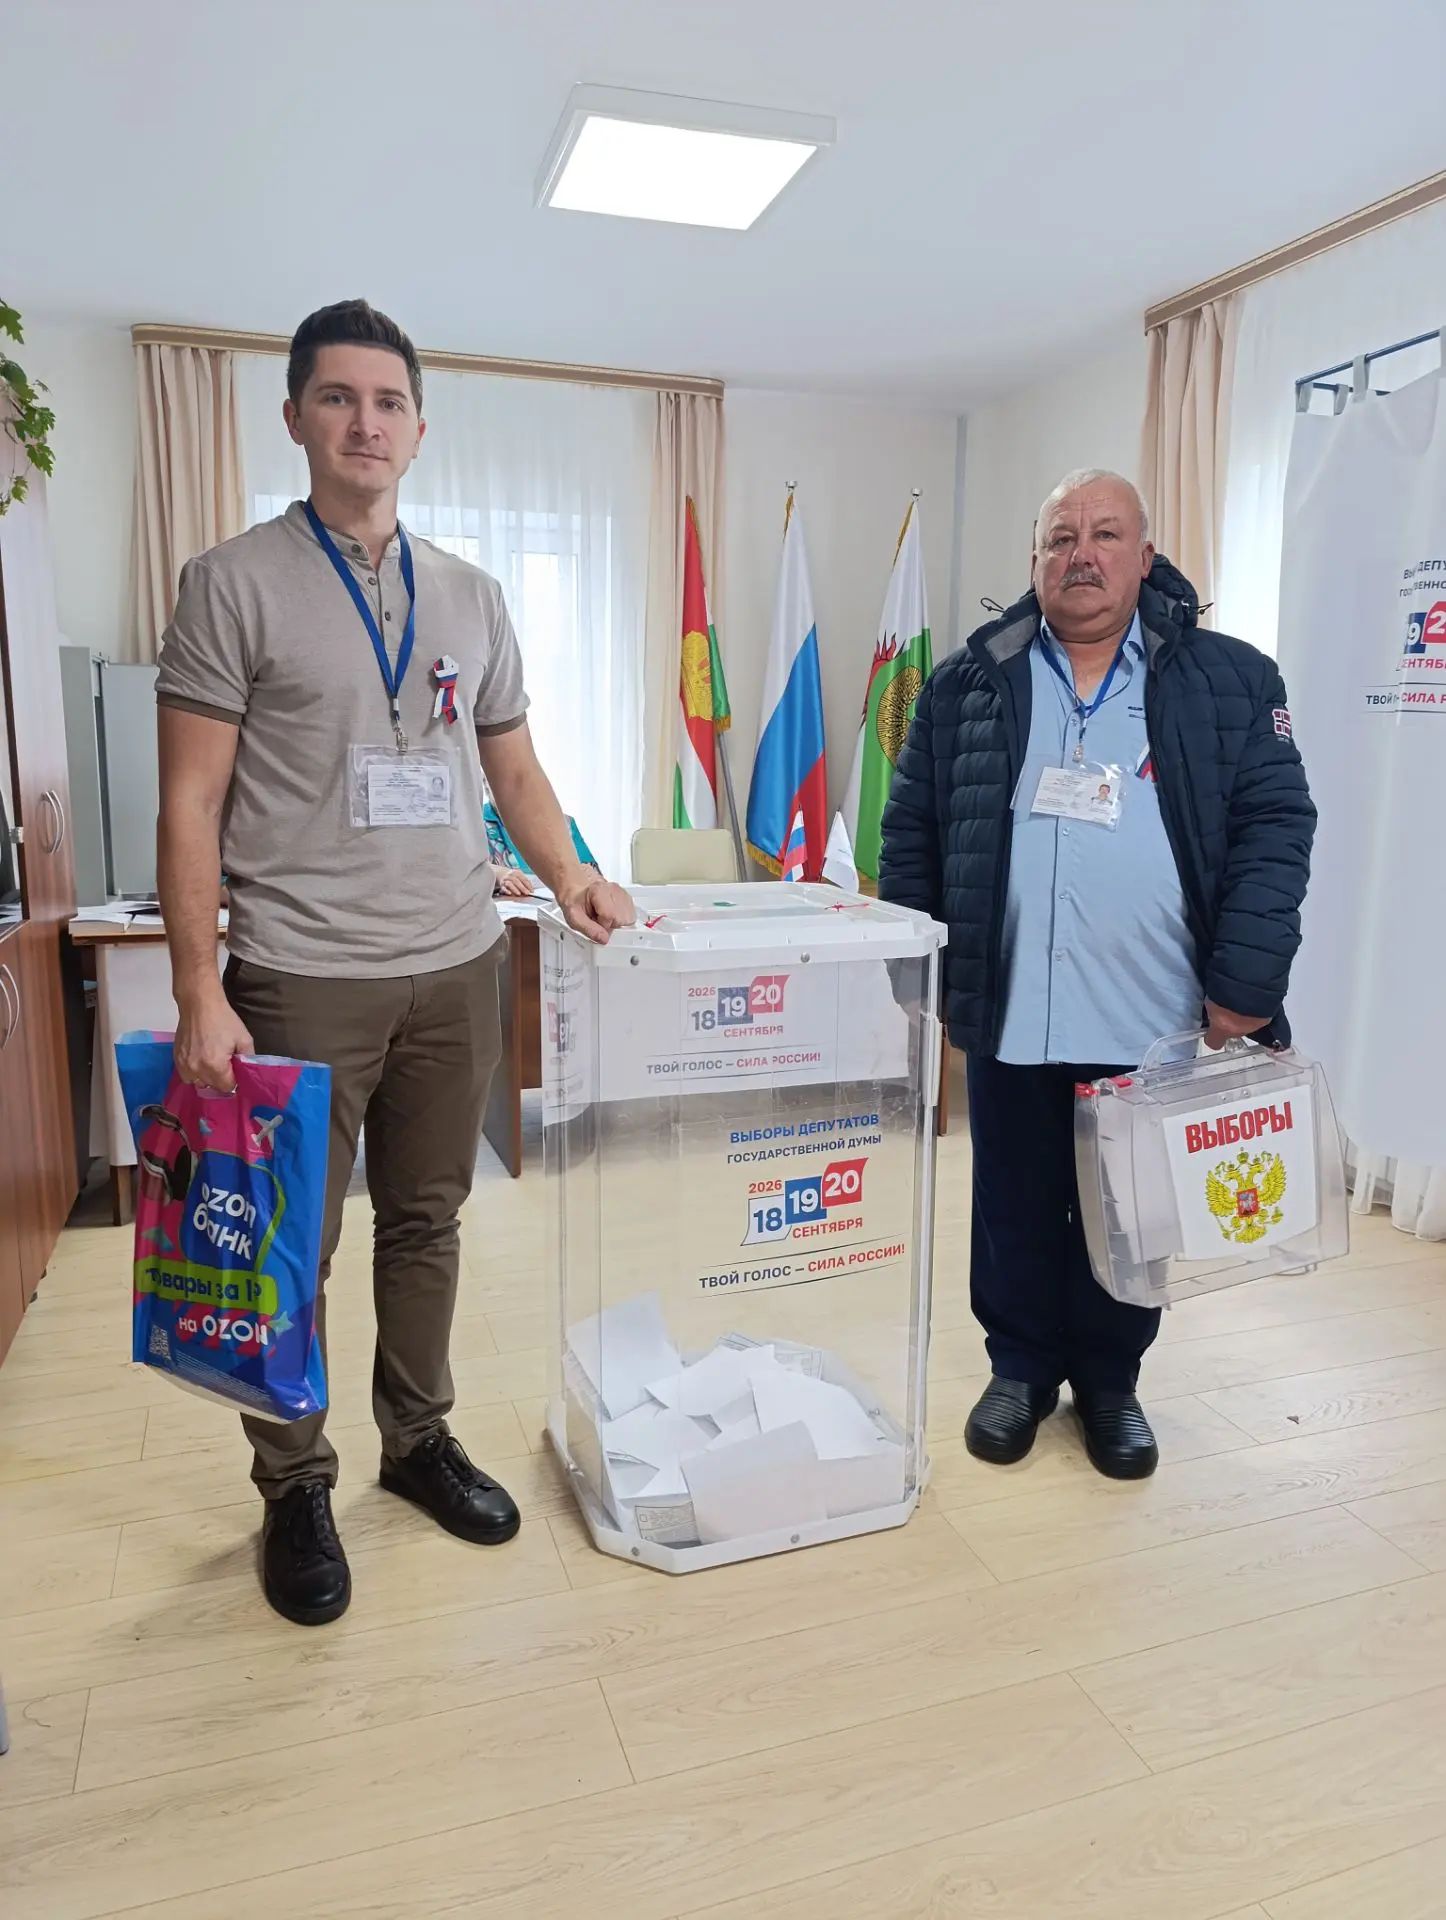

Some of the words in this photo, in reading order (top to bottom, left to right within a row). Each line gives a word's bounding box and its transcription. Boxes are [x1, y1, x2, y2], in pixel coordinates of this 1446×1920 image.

[1401, 658, 1446, 669] ЕНТЯБ
[1401, 692, 1436, 704] СИЛА
[751, 984, 782, 1006] 20
[720, 996, 747, 1018] 19
[691, 1009, 716, 1032] 18
[723, 1024, 784, 1039] СЕНТЯБРЯ
[646, 1060, 679, 1075] ТВОЙ
[682, 1059, 723, 1072] ГОЛОС
[736, 1056, 768, 1069] СИЛА
[772, 1052, 822, 1065] РОССИИ!
[730, 1125, 795, 1144] ВЫБОРЫ
[798, 1113, 880, 1136] ДЕПУТАТОВ
[1184, 1101, 1294, 1154] ВЫБОРЫ
[727, 1138, 845, 1164] ГОСУДАРСТВЕННОЙ
[847, 1134, 881, 1149] ДУМЫ
[748, 1179, 782, 1194] 2026
[825, 1169, 860, 1197] 20
[202, 1182, 257, 1229] ozon
[789, 1188, 819, 1215] 19
[193, 1202, 252, 1261] банк
[753, 1207, 783, 1234] 18
[792, 1217, 863, 1239] СЕНТЯБРЯ
[699, 1270, 739, 1289] ТВОЙ
[743, 1265, 791, 1283] ГОЛОС
[808, 1254, 845, 1272] СИЛА
[849, 1243, 905, 1265] РОССИИ!
[178, 1317, 198, 1333] на
